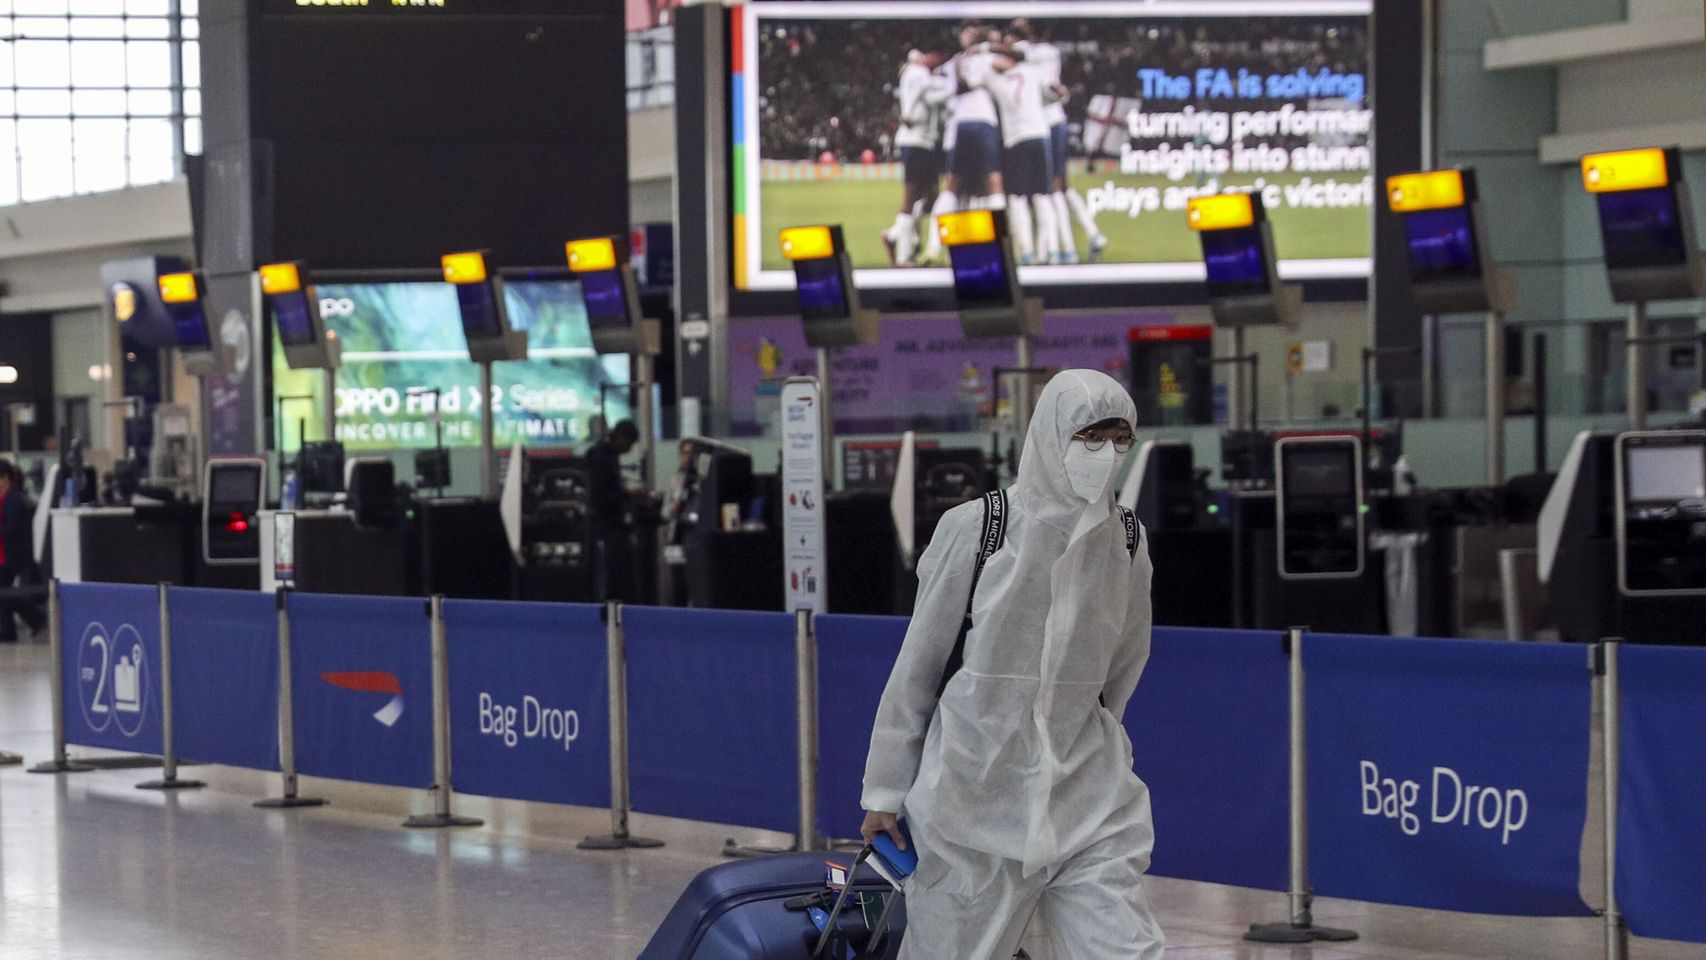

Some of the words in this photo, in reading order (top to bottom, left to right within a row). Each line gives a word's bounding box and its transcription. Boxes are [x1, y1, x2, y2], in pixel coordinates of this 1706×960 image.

[1136, 67, 1192, 99] The
[1195, 67, 1234, 98] FA
[1237, 67, 1263, 98] is
[1266, 66, 1365, 103] solving
[1127, 104, 1229, 144] turning
[1120, 142, 1230, 181] insights
[1231, 141, 1289, 172] into
[1086, 180, 1160, 218] plays
[509, 384, 580, 414] Series
[991, 496, 1001, 517] KORS
[1126, 516, 1134, 545] KORS
[91, 634, 109, 713] 2
[480, 691, 518, 748] Bag
[523, 694, 579, 751] Drop
[1360, 760, 1420, 836] Bag
[1431, 766, 1528, 845] Drop
